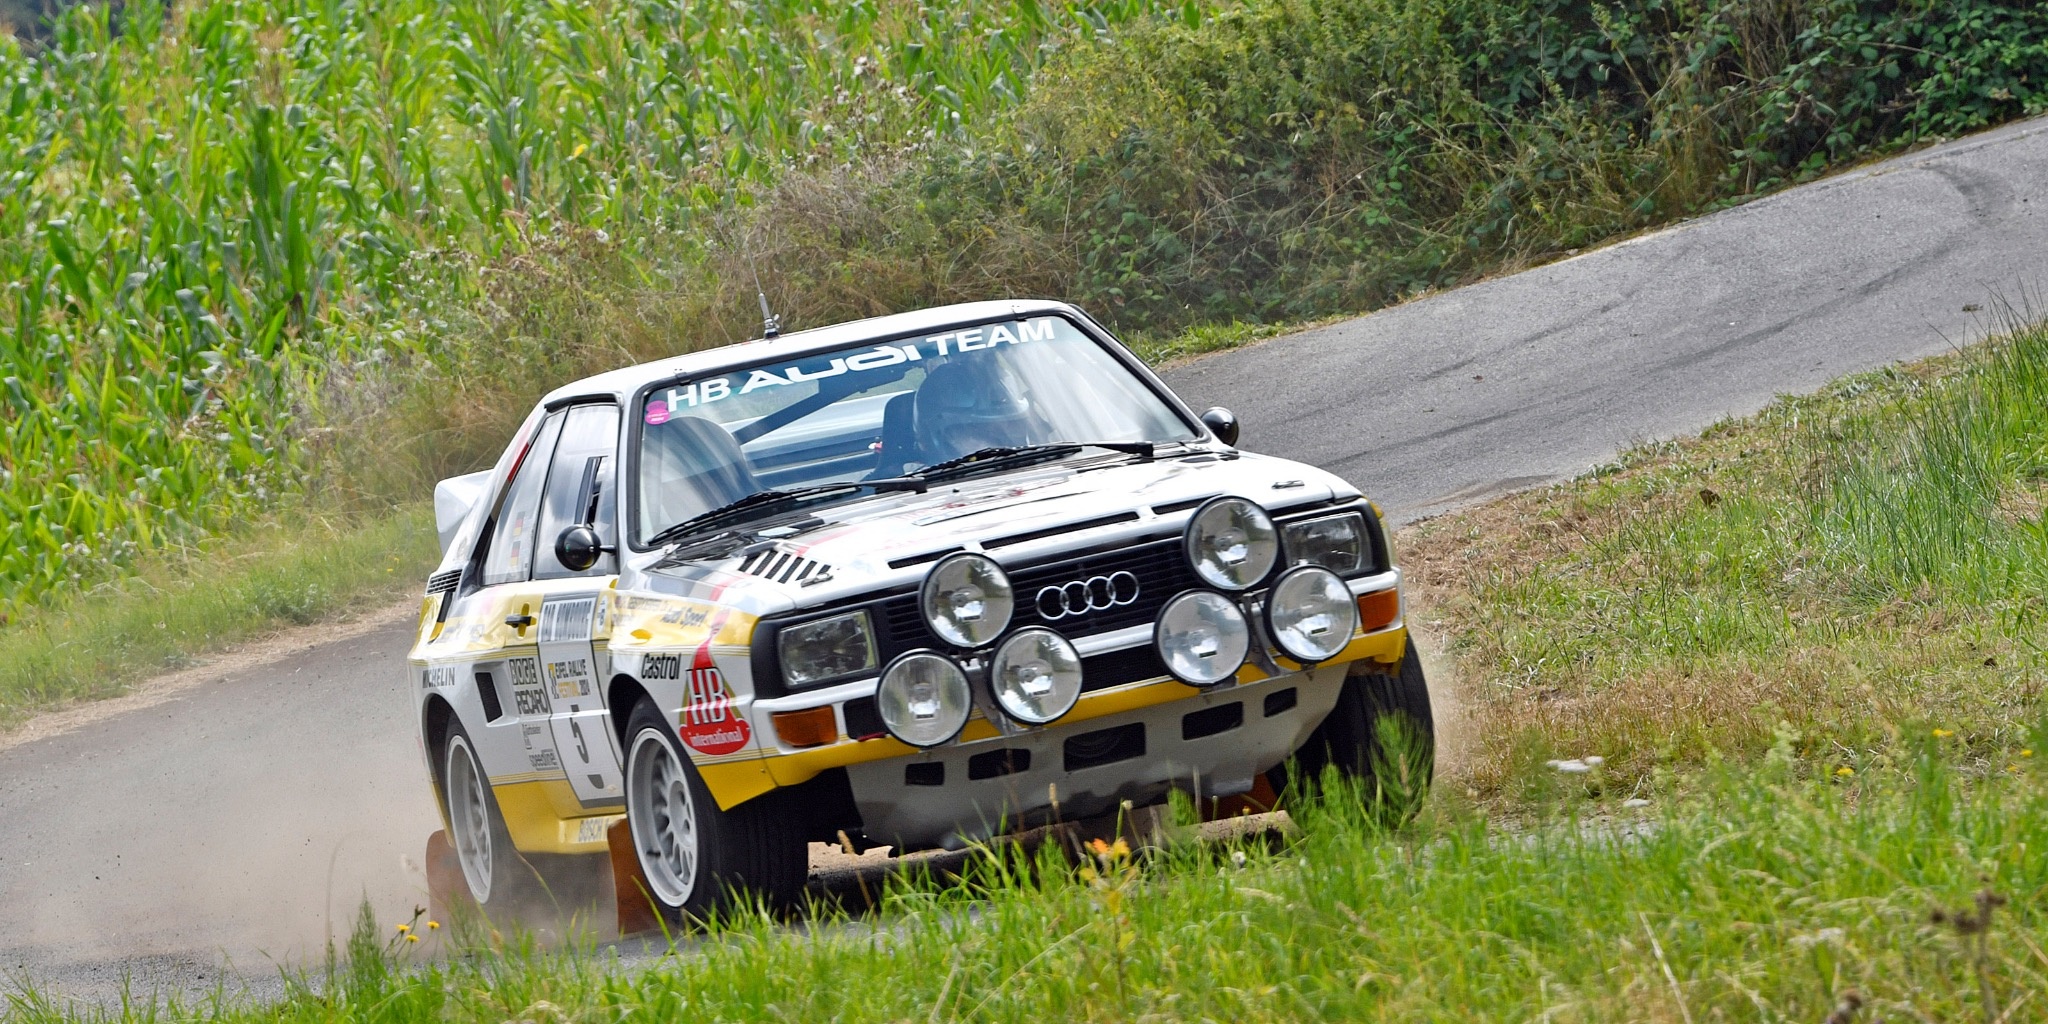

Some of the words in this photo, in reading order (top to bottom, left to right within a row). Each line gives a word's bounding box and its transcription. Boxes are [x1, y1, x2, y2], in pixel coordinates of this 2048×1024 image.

[667, 377, 731, 412] HB
[926, 319, 1056, 356] TEAM
[422, 667, 455, 689] MICHELIN
[554, 661, 569, 679] EIFEL
[568, 658, 588, 677] RALLYE
[641, 652, 682, 680] Castrol
[515, 688, 549, 714] RECARO
[685, 666, 727, 725] HB
[569, 703, 590, 764] 5
[688, 725, 745, 747] international
[578, 818, 604, 843] BOSCH
